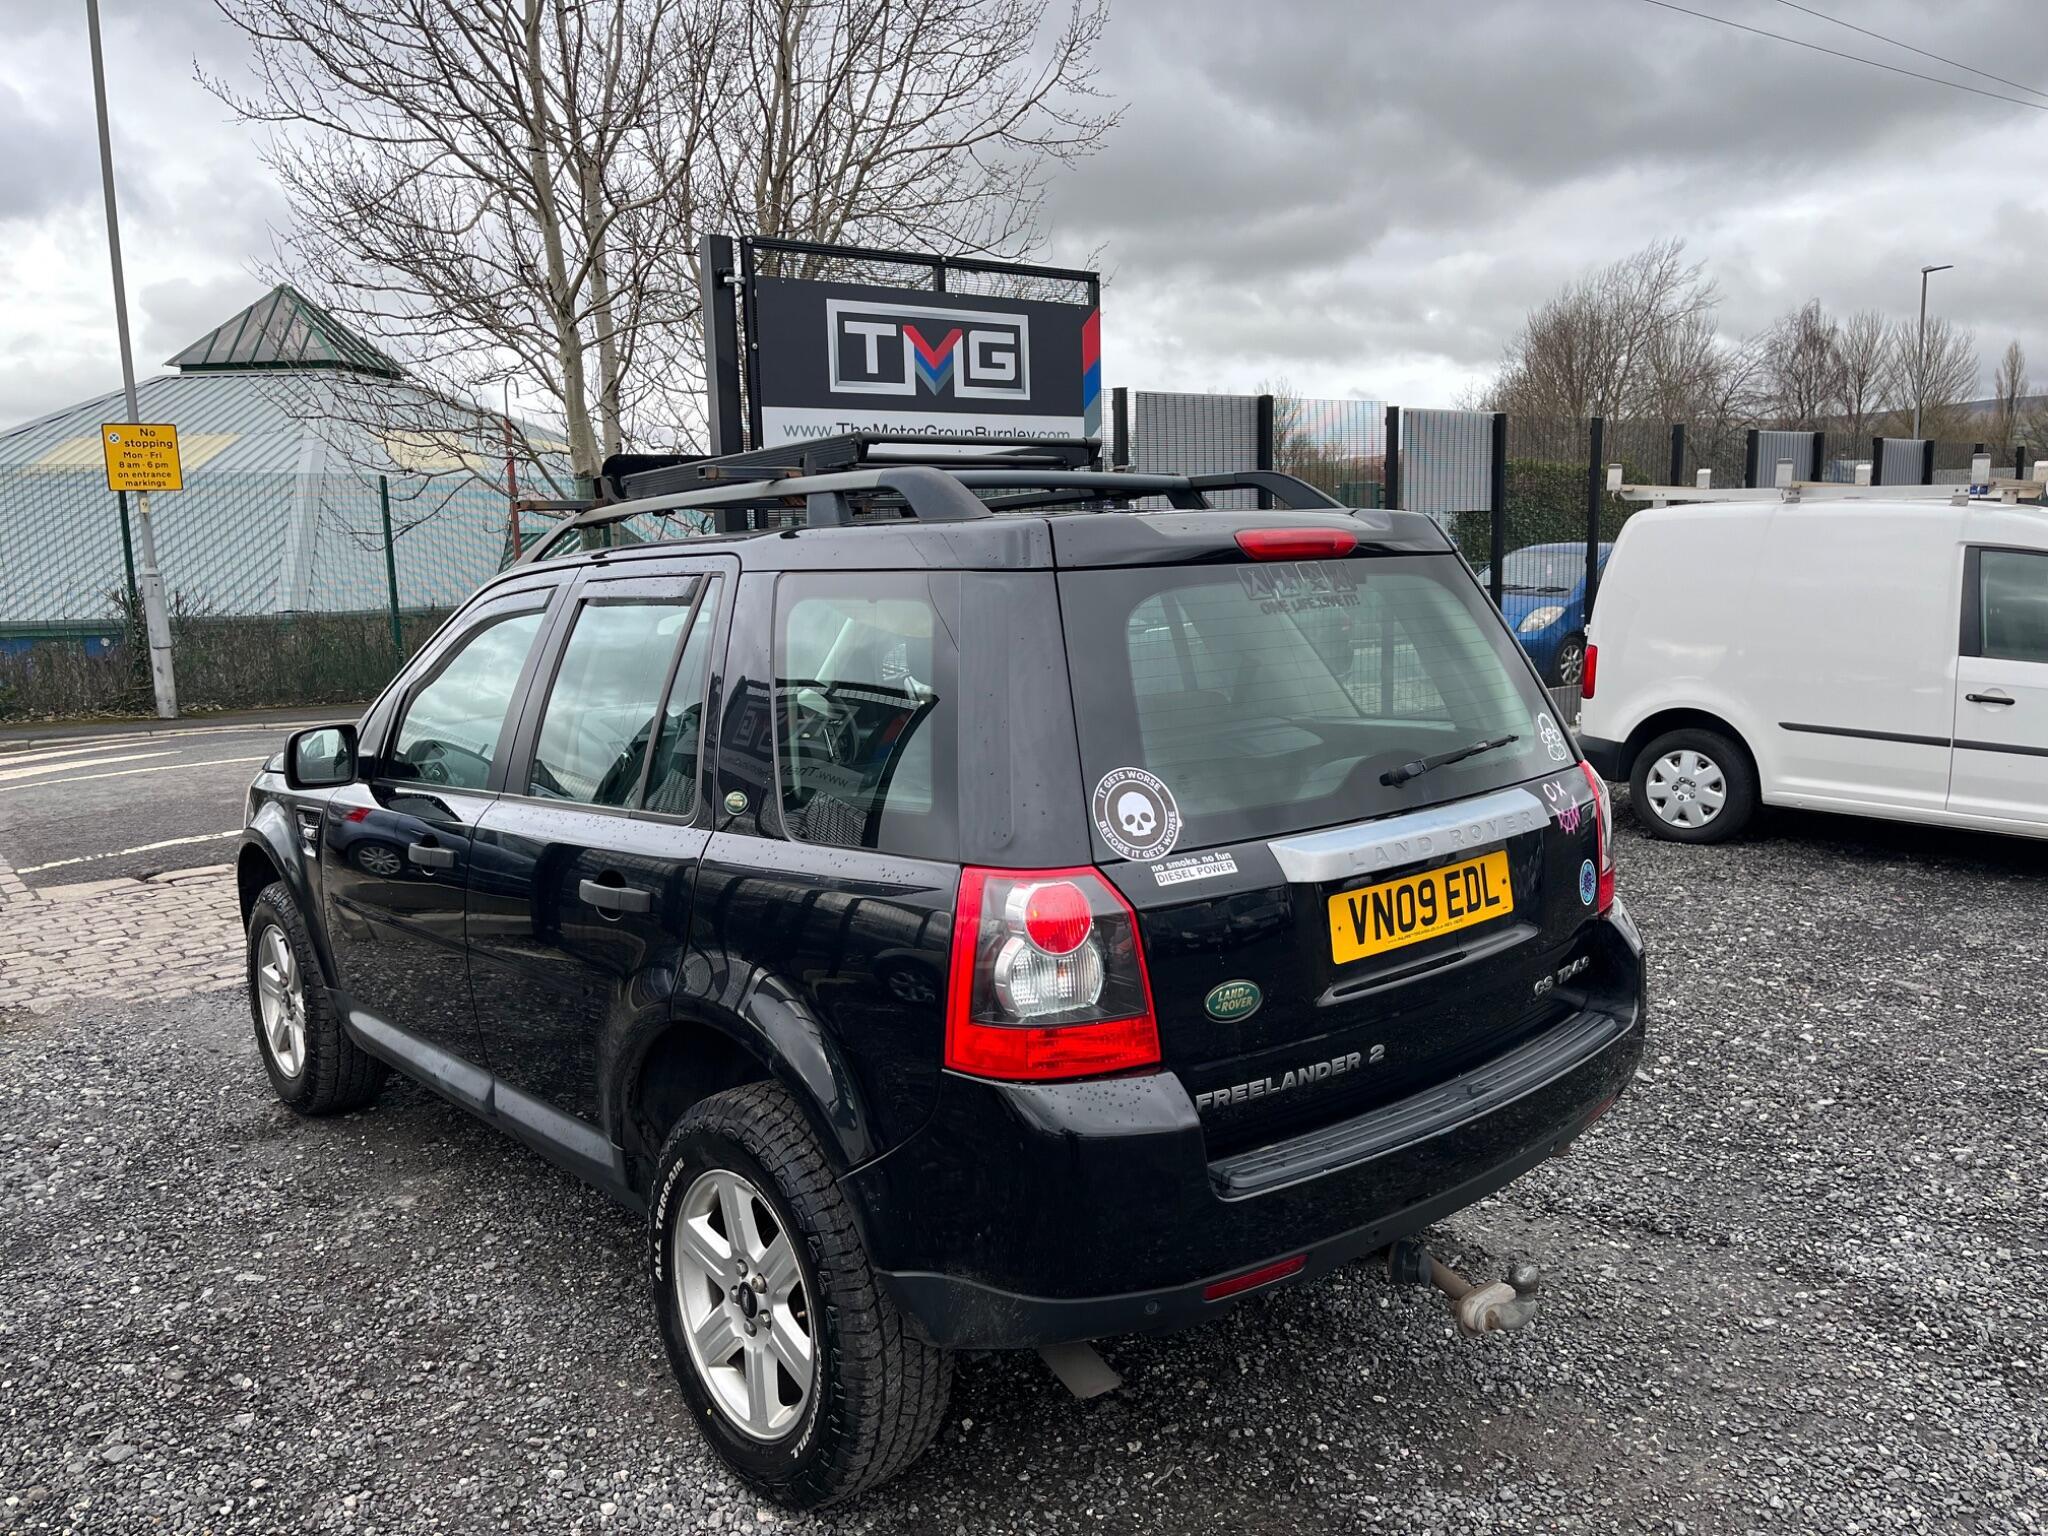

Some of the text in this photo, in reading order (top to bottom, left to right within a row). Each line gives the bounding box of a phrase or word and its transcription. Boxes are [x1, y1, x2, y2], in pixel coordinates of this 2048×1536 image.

[842, 319, 1017, 396] TMG
[139, 428, 156, 437] No
[783, 422, 1070, 438] wwwThMotorGrouBurnlecom
[123, 451, 143, 459] Mon
[150, 451, 162, 459] Fri
[124, 440, 173, 449] stopping
[125, 480, 166, 488] markings
[1097, 770, 1161, 799] IT GETS WORSE
[1098, 810, 1176, 859] BEFORE IT GETS WORSE
[1349, 810, 1536, 870] LAND ROVER
[1151, 863, 1164, 873] no
[1202, 854, 1214, 863] no
[1215, 851, 1232, 861] fun
[1157, 860, 1235, 884] DIESEL POWER
[1348, 878, 1438, 945] VN09
[1444, 862, 1500, 920] EDL
[1217, 986, 1245, 1003] LAND
[1534, 975, 1553, 996] GS
[1220, 995, 1253, 1012] ROVER
[1195, 1043, 1386, 1113] FREELANDER 2
[654, 1157, 685, 1282] ALL TERRAIN
